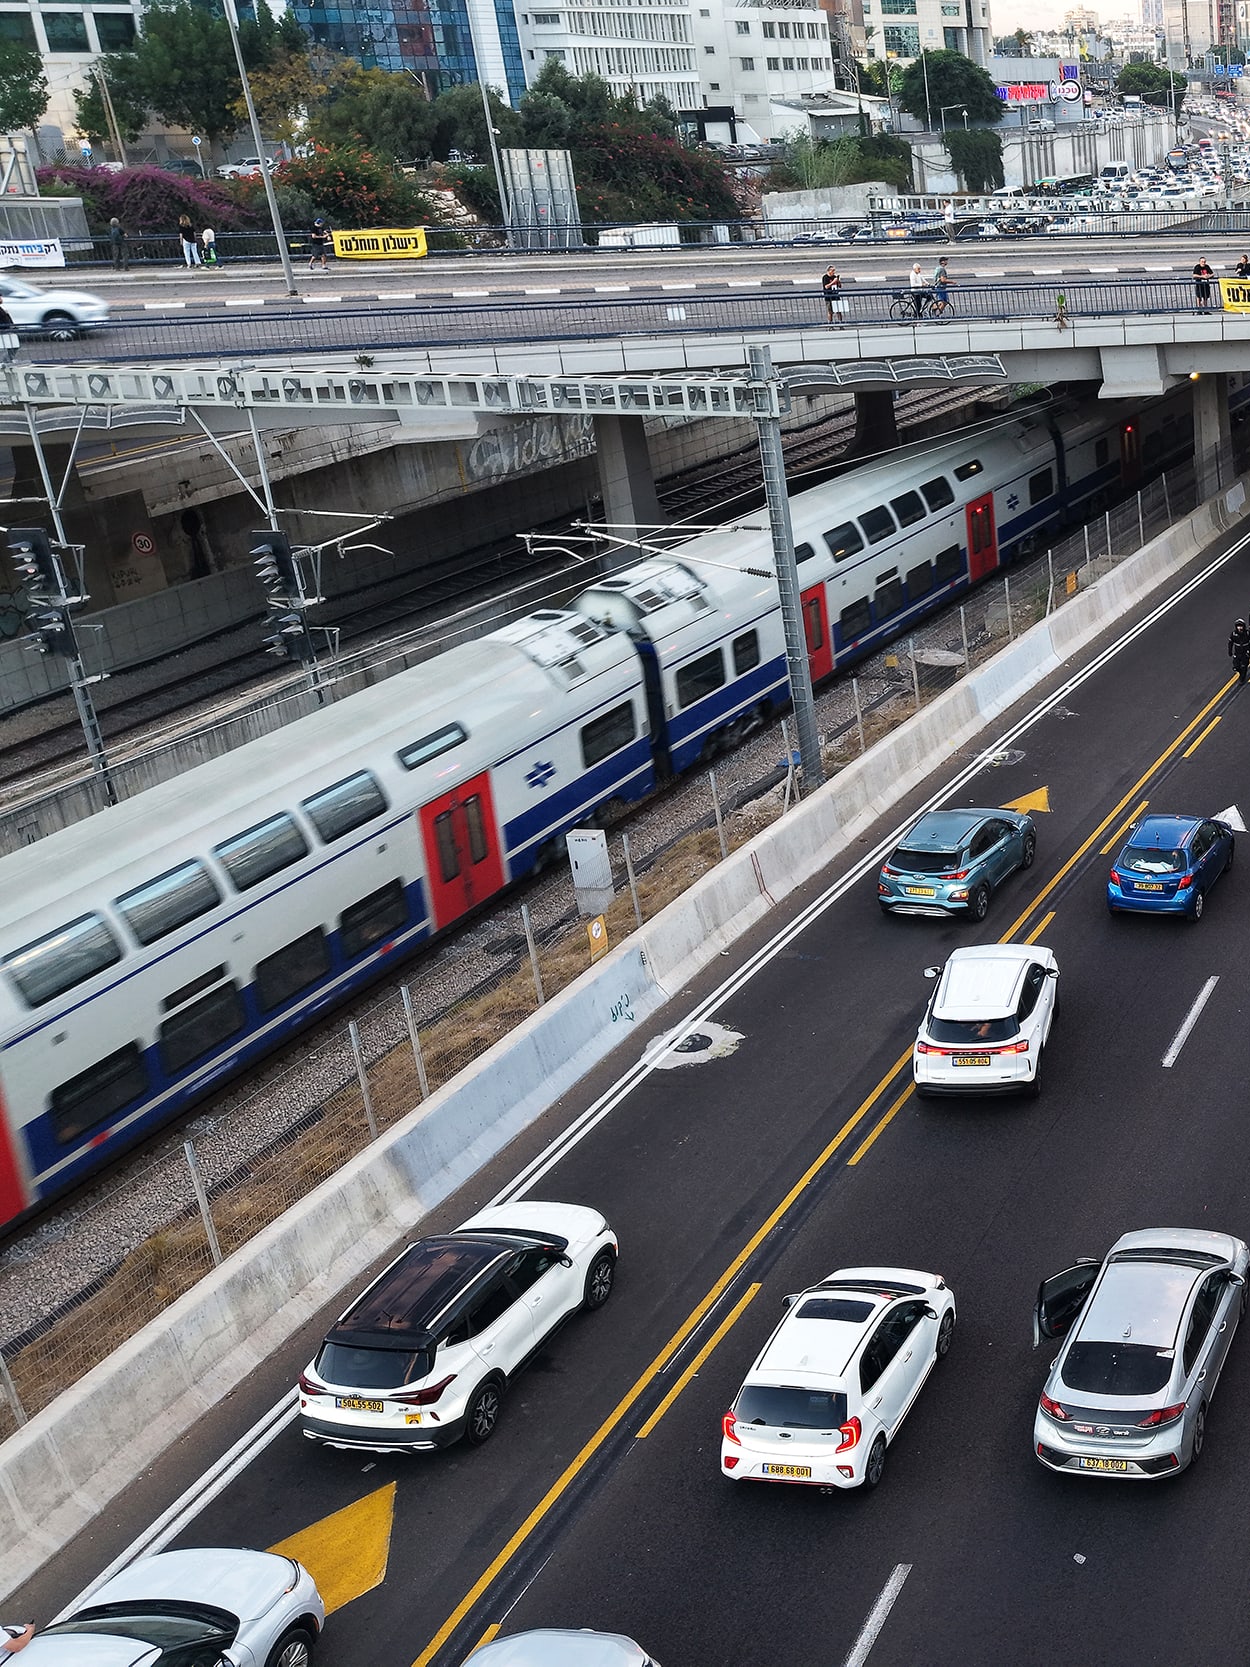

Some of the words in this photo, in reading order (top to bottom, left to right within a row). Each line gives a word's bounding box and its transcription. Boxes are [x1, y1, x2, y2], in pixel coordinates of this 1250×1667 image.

[19, 244, 44, 253] ביחד
[44, 243, 57, 254] רק
[381, 235, 419, 252] כישלון
[137, 539, 151, 549] 30
